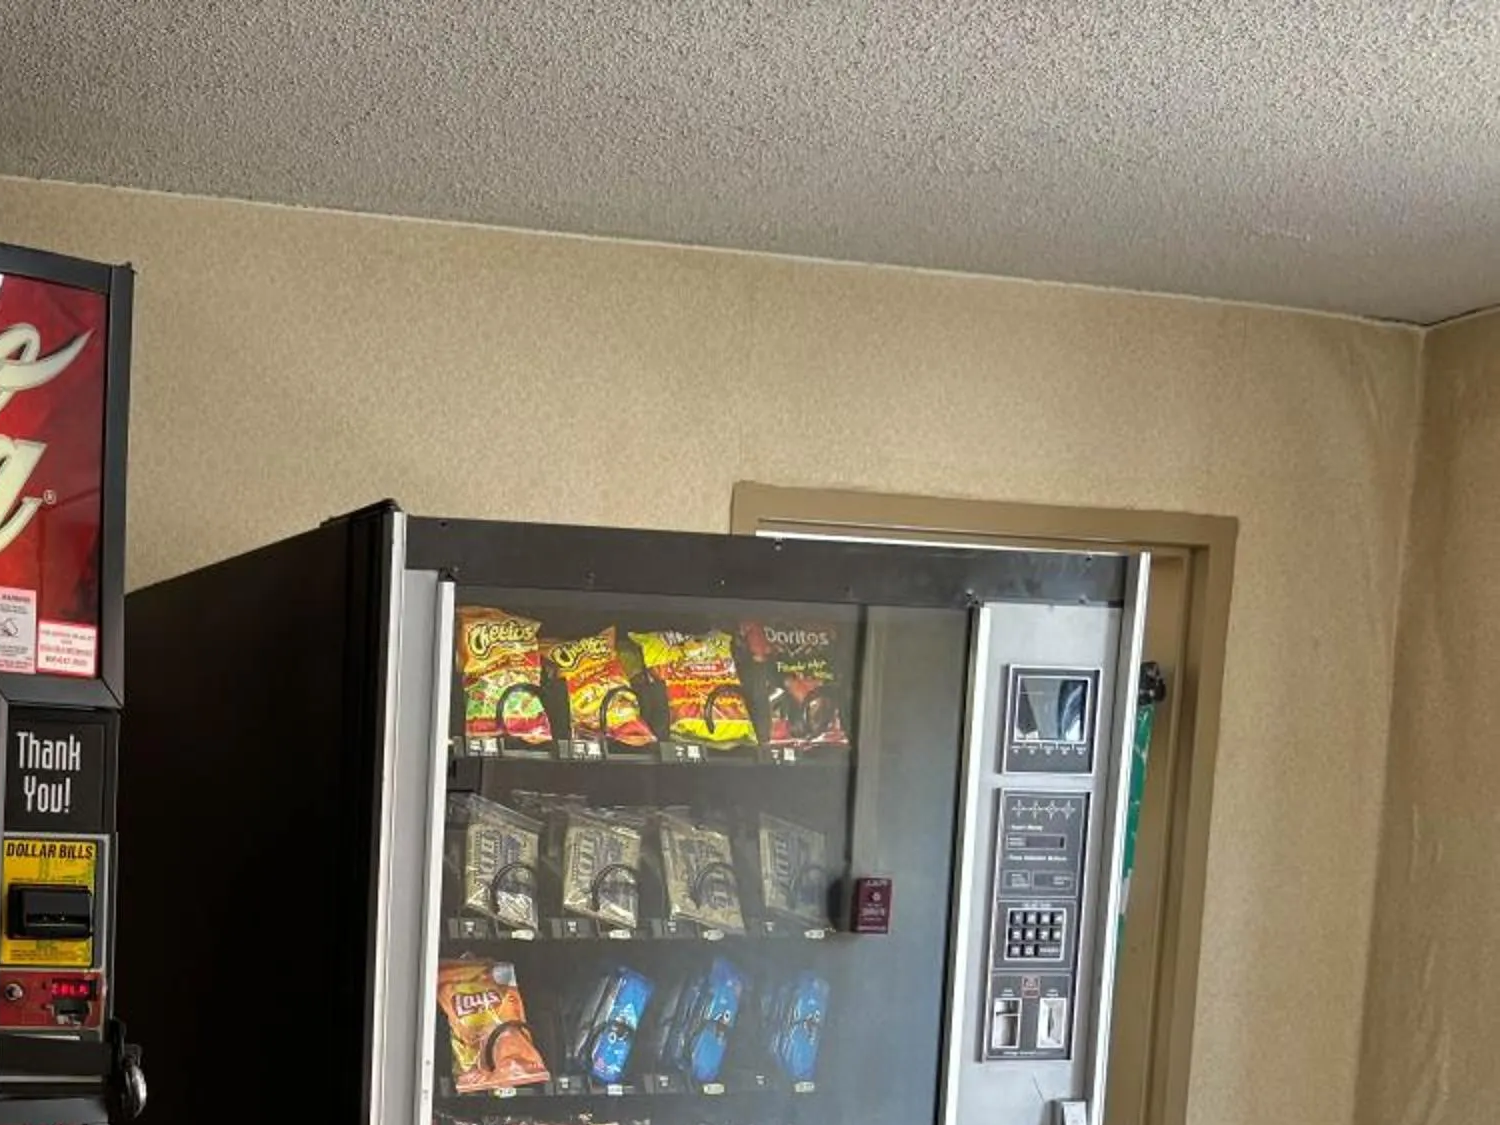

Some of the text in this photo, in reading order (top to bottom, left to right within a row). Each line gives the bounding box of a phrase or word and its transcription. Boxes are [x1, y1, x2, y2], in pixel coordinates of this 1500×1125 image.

[467, 619, 536, 656] Cheetos
[763, 626, 830, 646] Doritos
[16, 731, 81, 771] Thank
[23, 774, 72, 814] You!
[5, 842, 93, 859] DOLLAR BILLS
[454, 991, 501, 1018] Lay's
